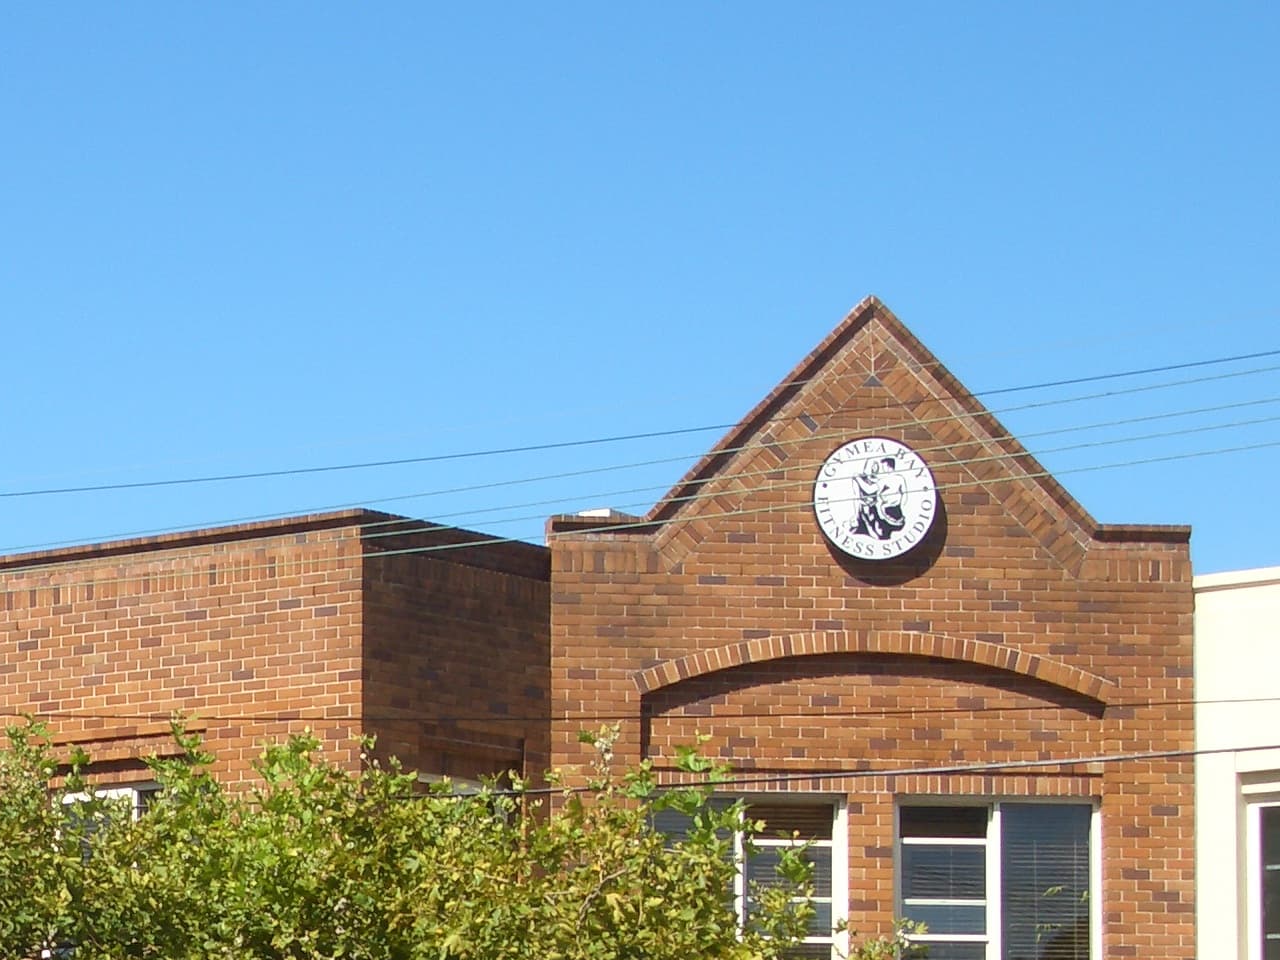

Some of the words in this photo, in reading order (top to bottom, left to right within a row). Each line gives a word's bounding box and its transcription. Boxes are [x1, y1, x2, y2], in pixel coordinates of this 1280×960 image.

[823, 440, 887, 478] GYMEA
[893, 447, 928, 481] BAY
[817, 496, 875, 557] FITNESS
[882, 498, 933, 556] STUDIO
